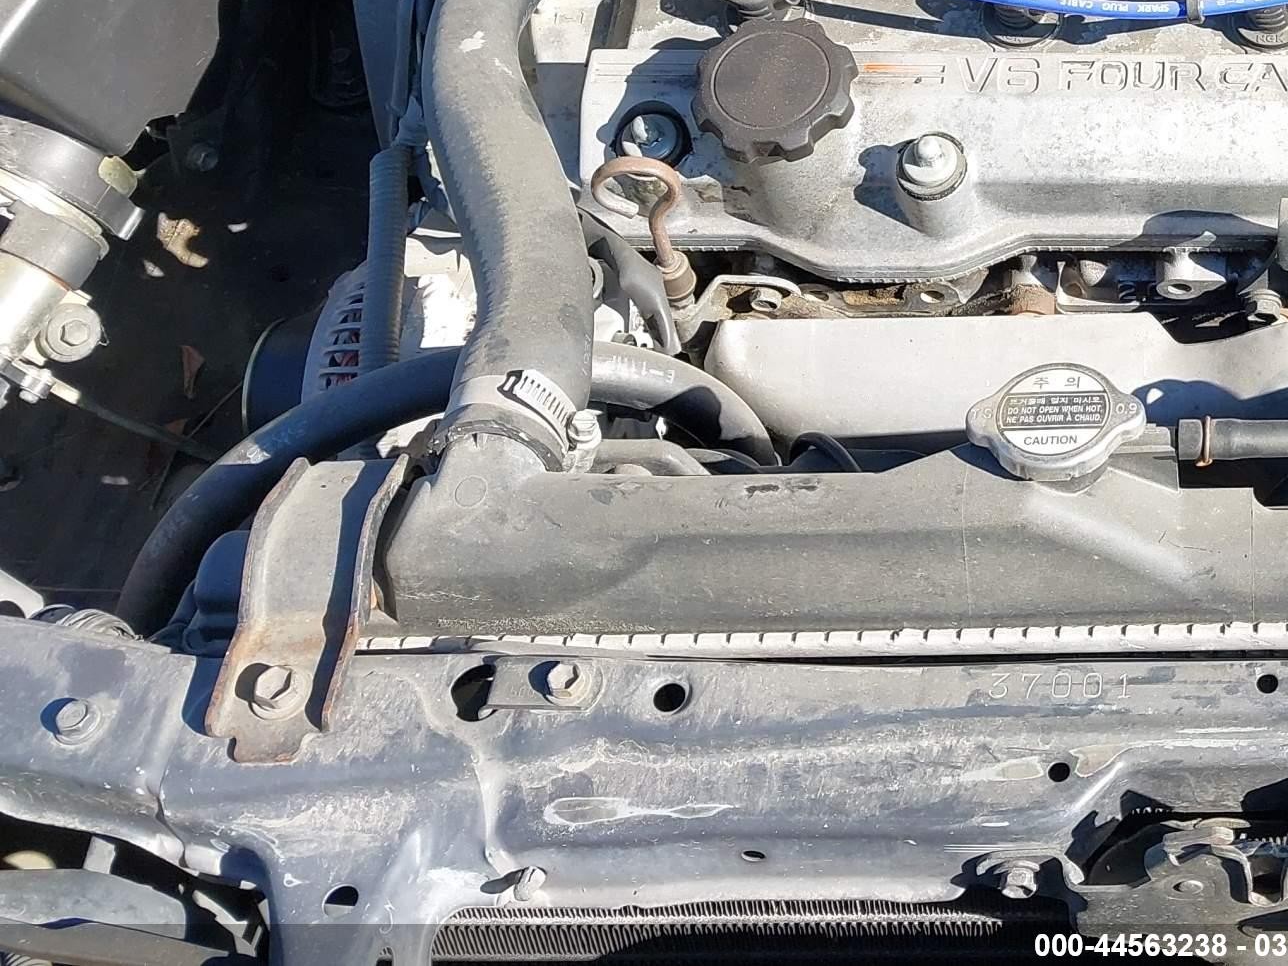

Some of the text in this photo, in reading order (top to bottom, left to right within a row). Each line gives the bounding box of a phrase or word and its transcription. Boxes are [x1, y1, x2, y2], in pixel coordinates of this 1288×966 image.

[1102, 1, 1129, 13] PLUG
[1136, 1, 1170, 13] SPARK
[958, 57, 1041, 94] V6
[1061, 60, 1207, 91] FOUR
[1007, 407, 1019, 415] DO
[1021, 406, 1036, 414] NOT
[1038, 405, 1060, 414] OPEN
[1061, 405, 1083, 414] WHEN
[1115, 403, 1138, 414] 0.9
[1006, 415, 1017, 424] NE
[1019, 415, 1034, 423] PAS
[1036, 414, 1064, 423] OUVRIR
[1023, 435, 1078, 446] CAUTION
[988, 672, 1131, 699] 37001
